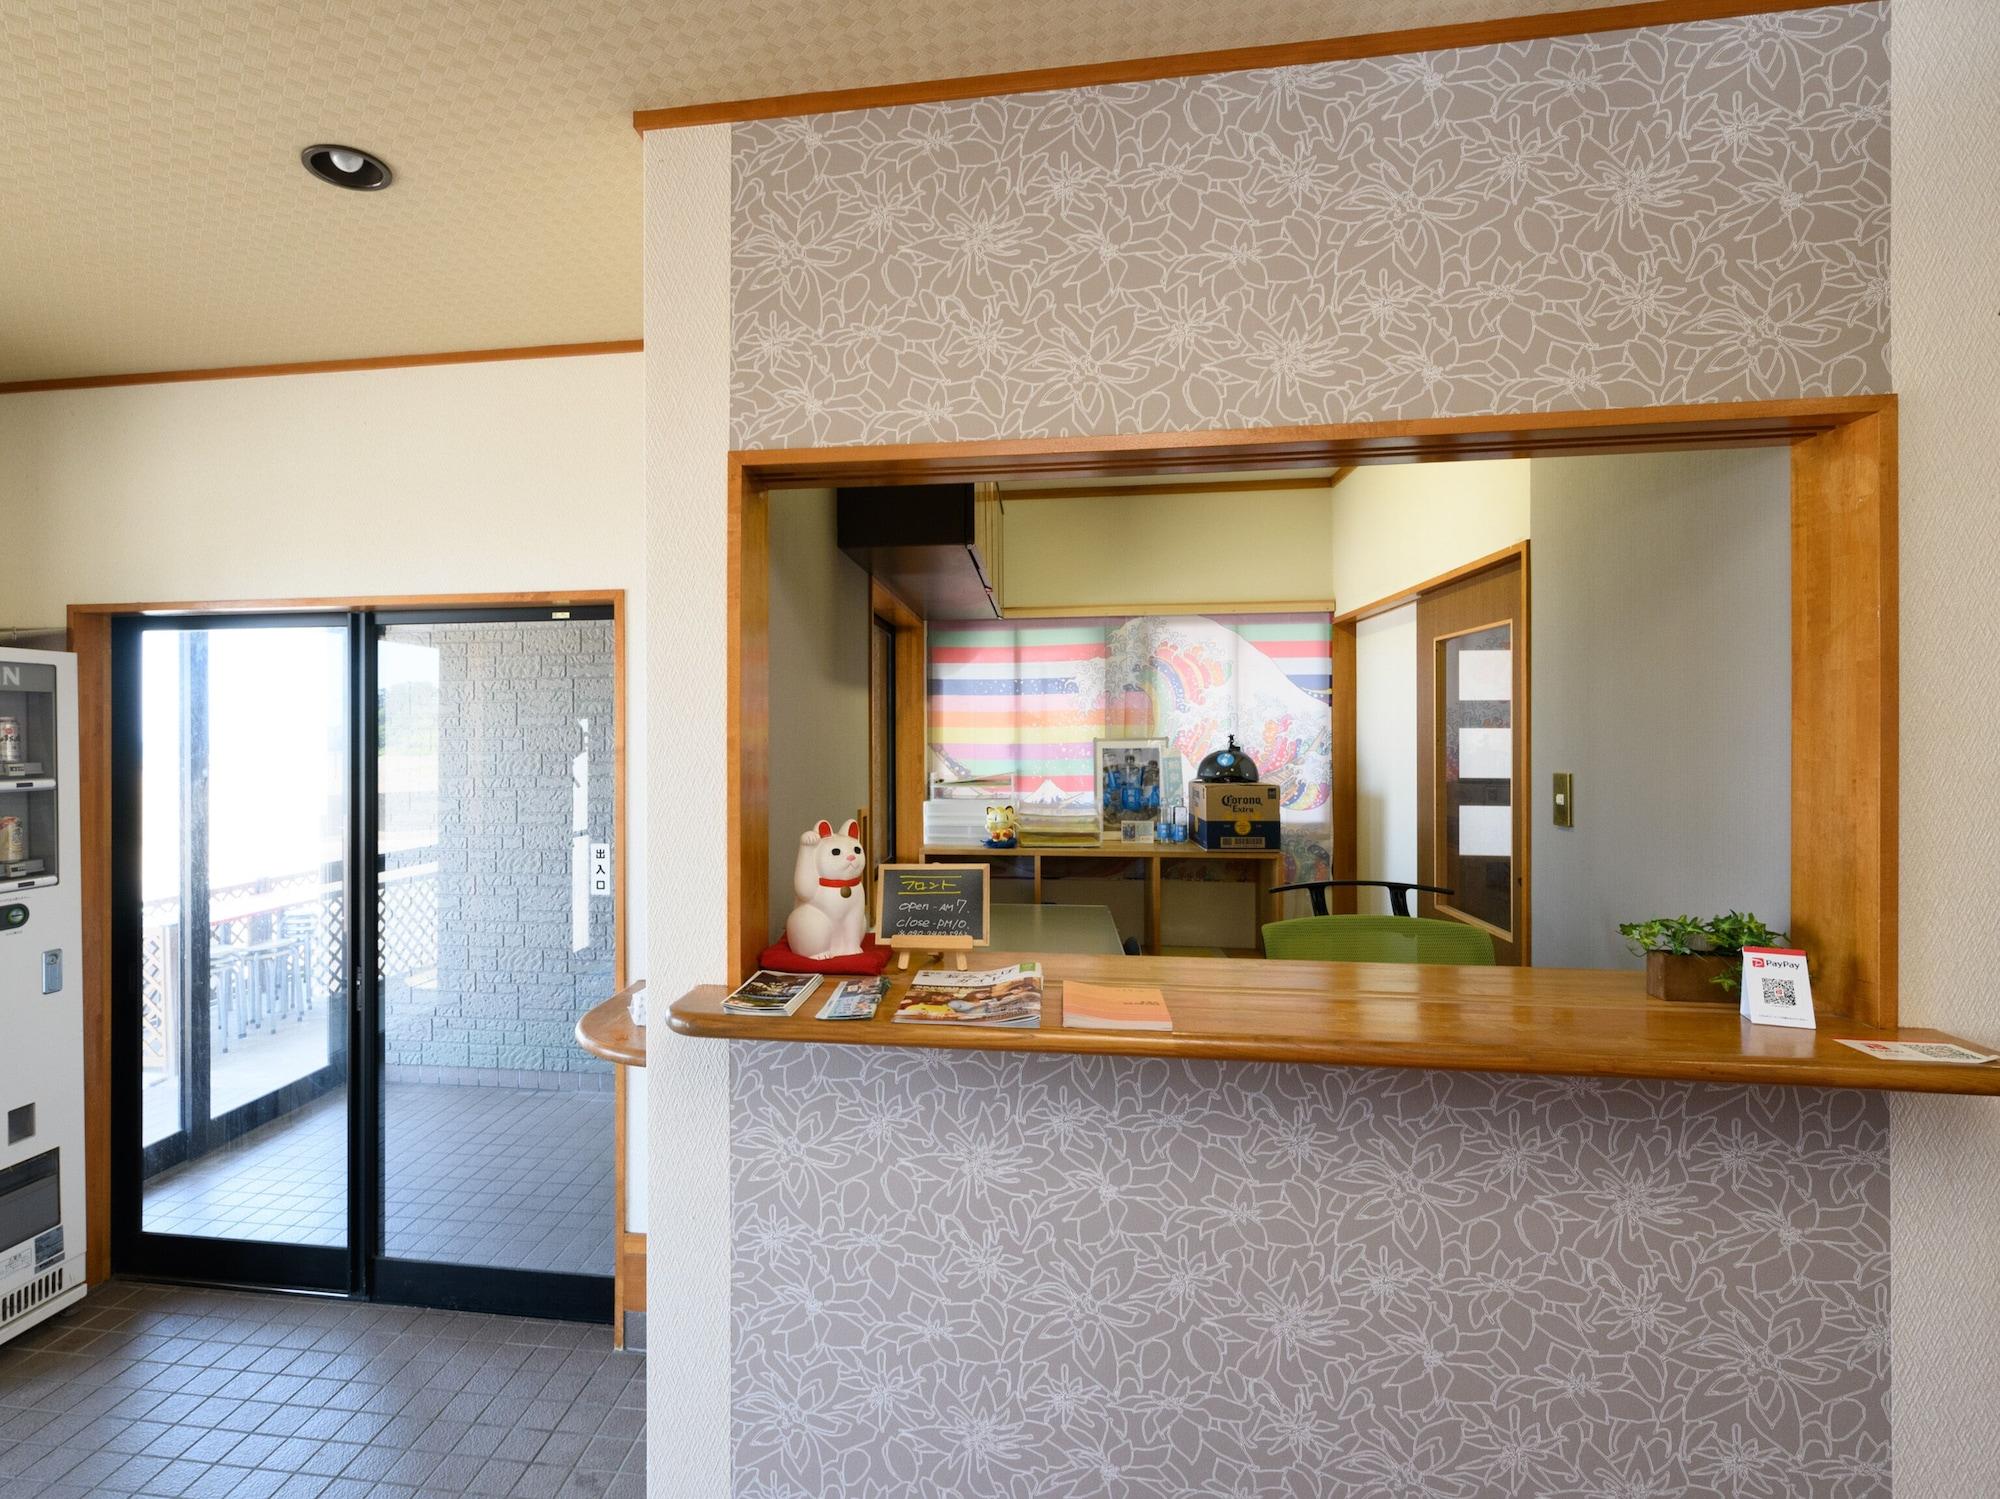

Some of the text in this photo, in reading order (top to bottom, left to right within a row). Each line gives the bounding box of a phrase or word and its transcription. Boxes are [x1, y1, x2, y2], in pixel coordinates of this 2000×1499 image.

[1221, 794, 1263, 808] Corona
[1232, 805, 1254, 813] Extra
[596, 849, 606, 890] 出入口
[901, 880, 957, 891] フロント
[1766, 959, 1800, 971] PayPay
